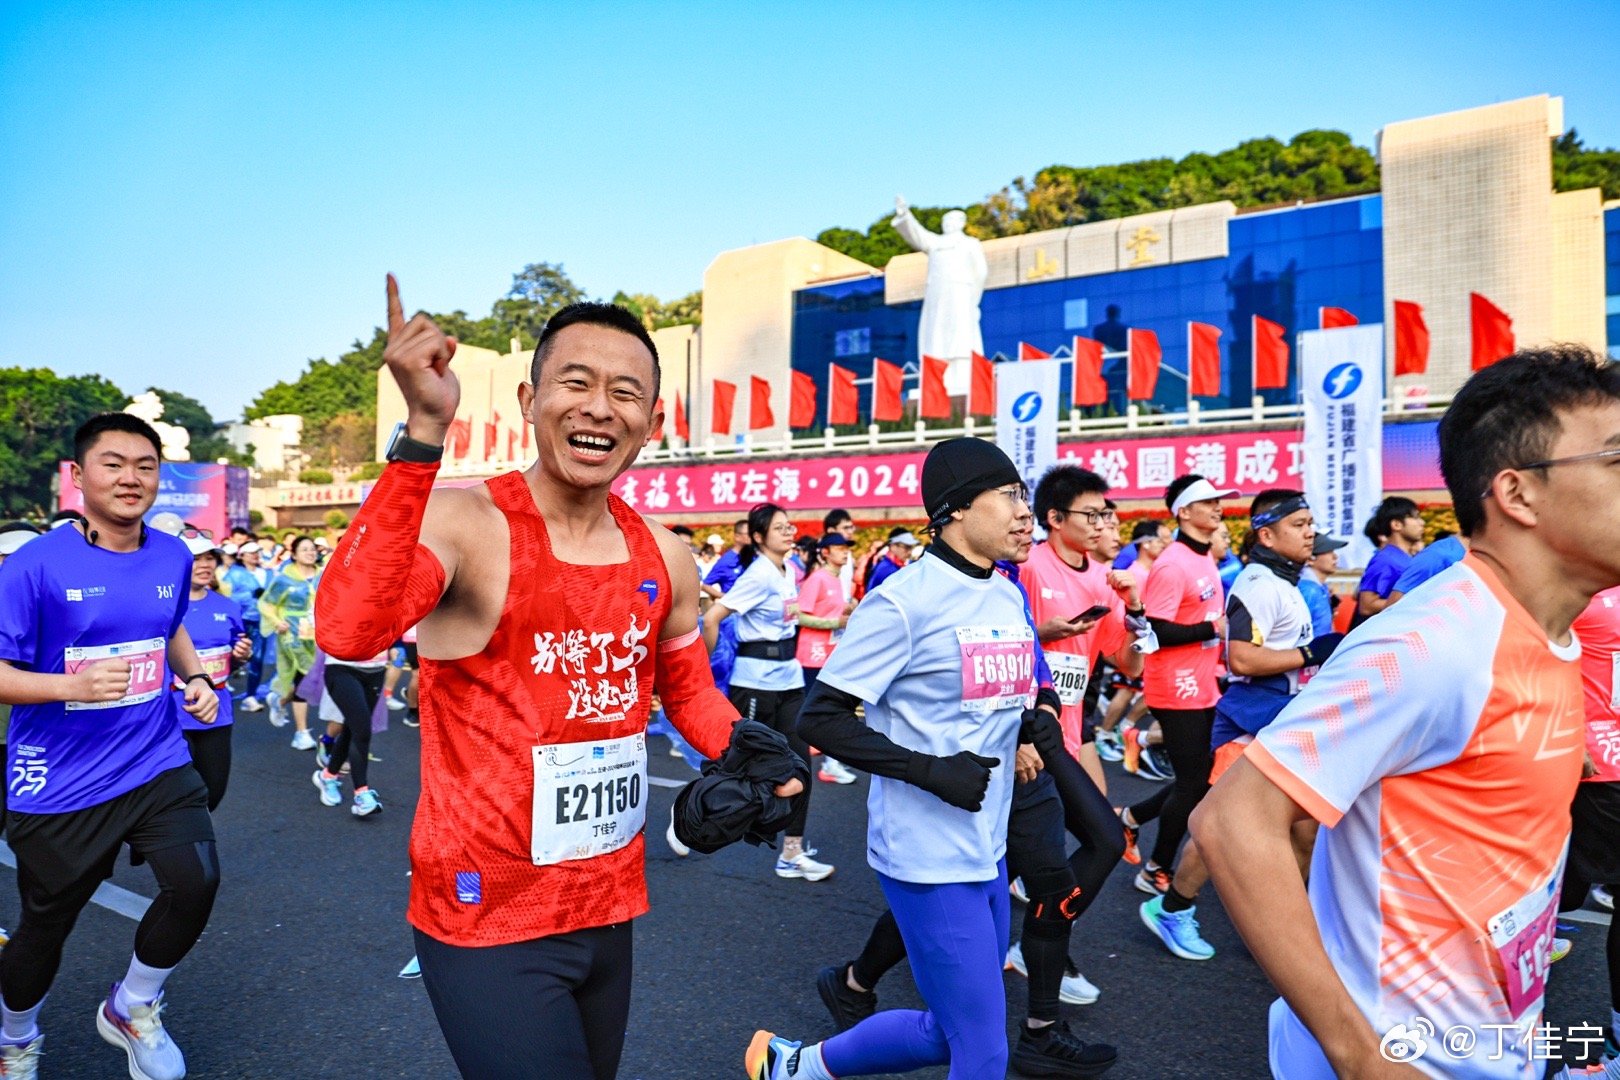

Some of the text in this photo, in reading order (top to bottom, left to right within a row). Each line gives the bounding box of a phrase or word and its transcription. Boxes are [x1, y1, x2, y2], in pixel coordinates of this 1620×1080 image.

[1327, 404, 1335, 449] FUJIAN
[711, 464, 919, 505] 祝左海·2024
[1327, 454, 1335, 490] MEDIA
[973, 652, 1031, 685] E63914
[556, 773, 640, 825] E21150
[592, 821, 617, 837] 丁佳宁
